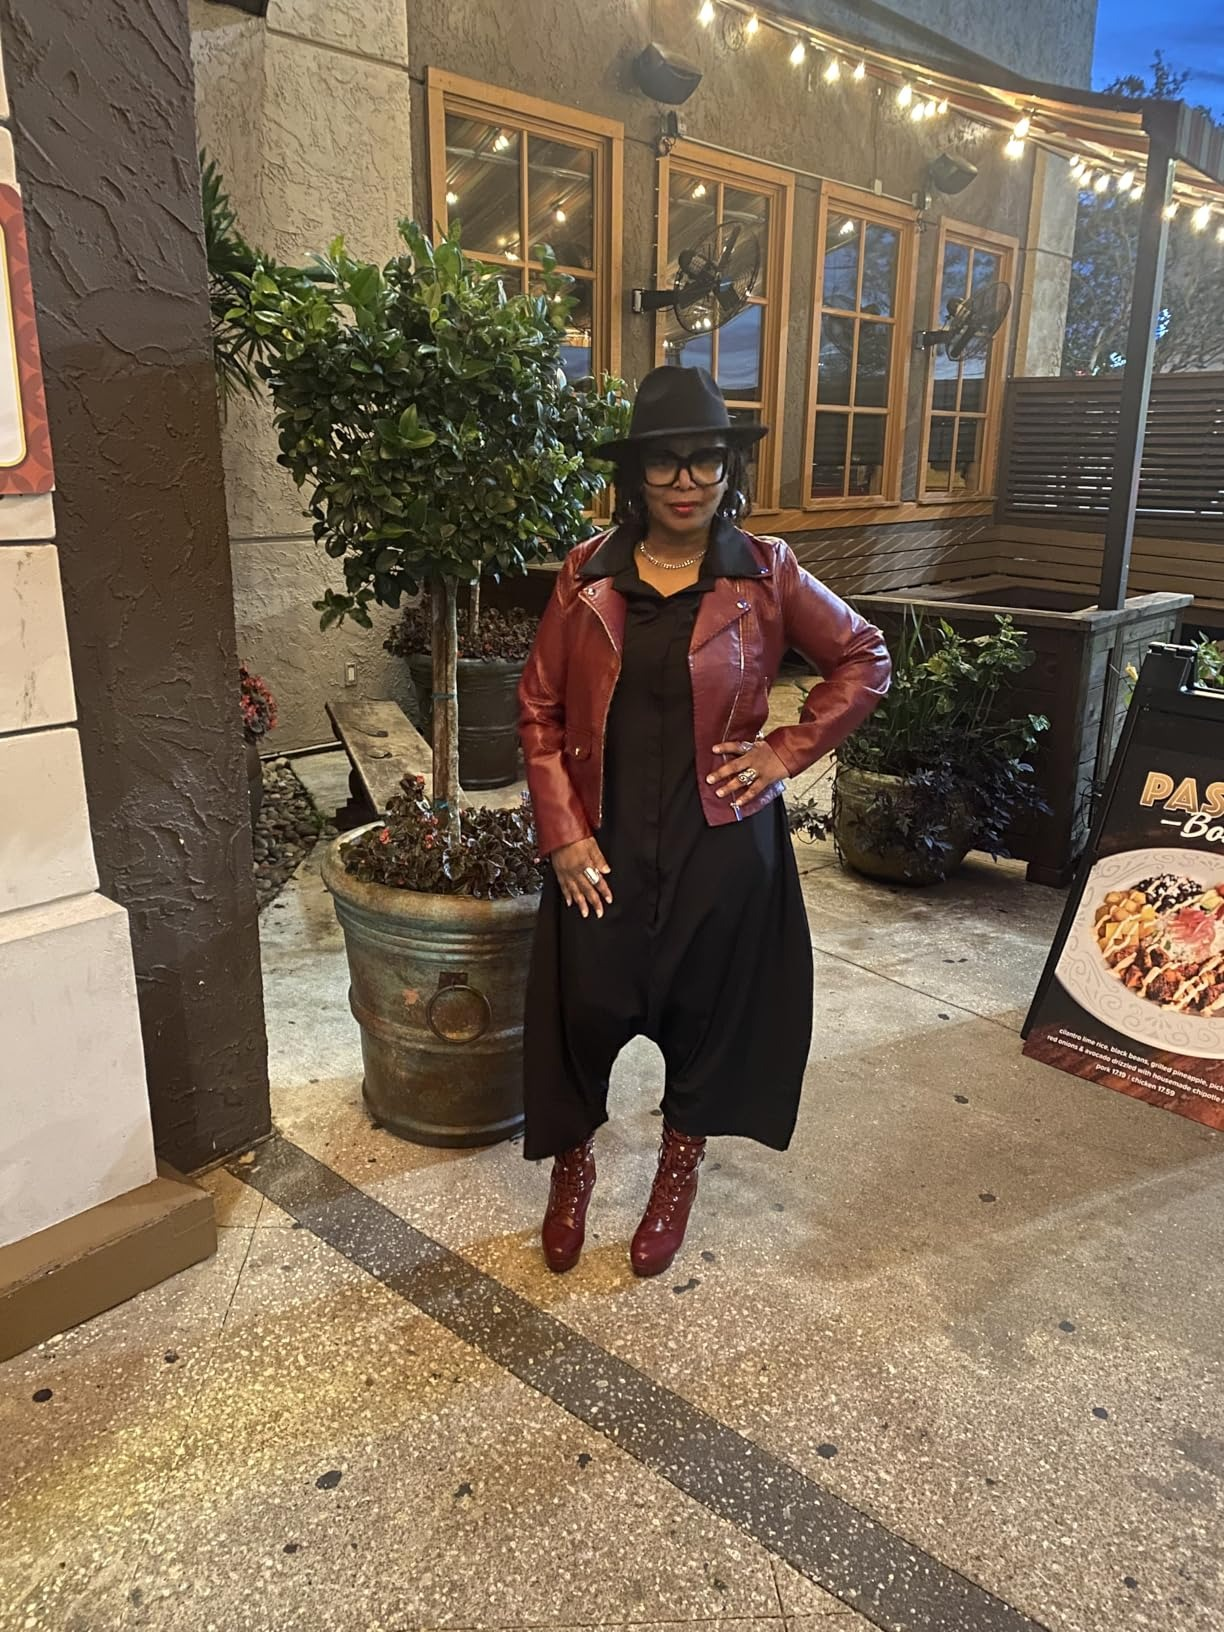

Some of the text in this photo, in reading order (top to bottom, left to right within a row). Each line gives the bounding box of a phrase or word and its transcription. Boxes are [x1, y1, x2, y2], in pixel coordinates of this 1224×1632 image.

[1139, 771, 1224, 818] PAS
[1047, 1035, 1059, 1043] red
[1058, 1039, 1079, 1050] onions
[1084, 1049, 1111, 1062] avocado
[1111, 1058, 1137, 1072] drizzled
[1137, 1068, 1152, 1077] with
[1152, 1072, 1192, 1092] housemade
[1192, 1088, 1221, 1103] chipotle
[1059, 1028, 1081, 1041] cilantro
[1082, 1036, 1096, 1046] lime
[1096, 1042, 1110, 1051] rice,
[1110, 1046, 1128, 1057] black
[1128, 1052, 1150, 1066] beans,
[1150, 1062, 1173, 1073] grilled
[1172, 1069, 1208, 1087] pineapple,
[1095, 1063, 1111, 1073] pork
[1131, 1076, 1157, 1090] chicken
[1158, 1086, 1176, 1097] 17.59
